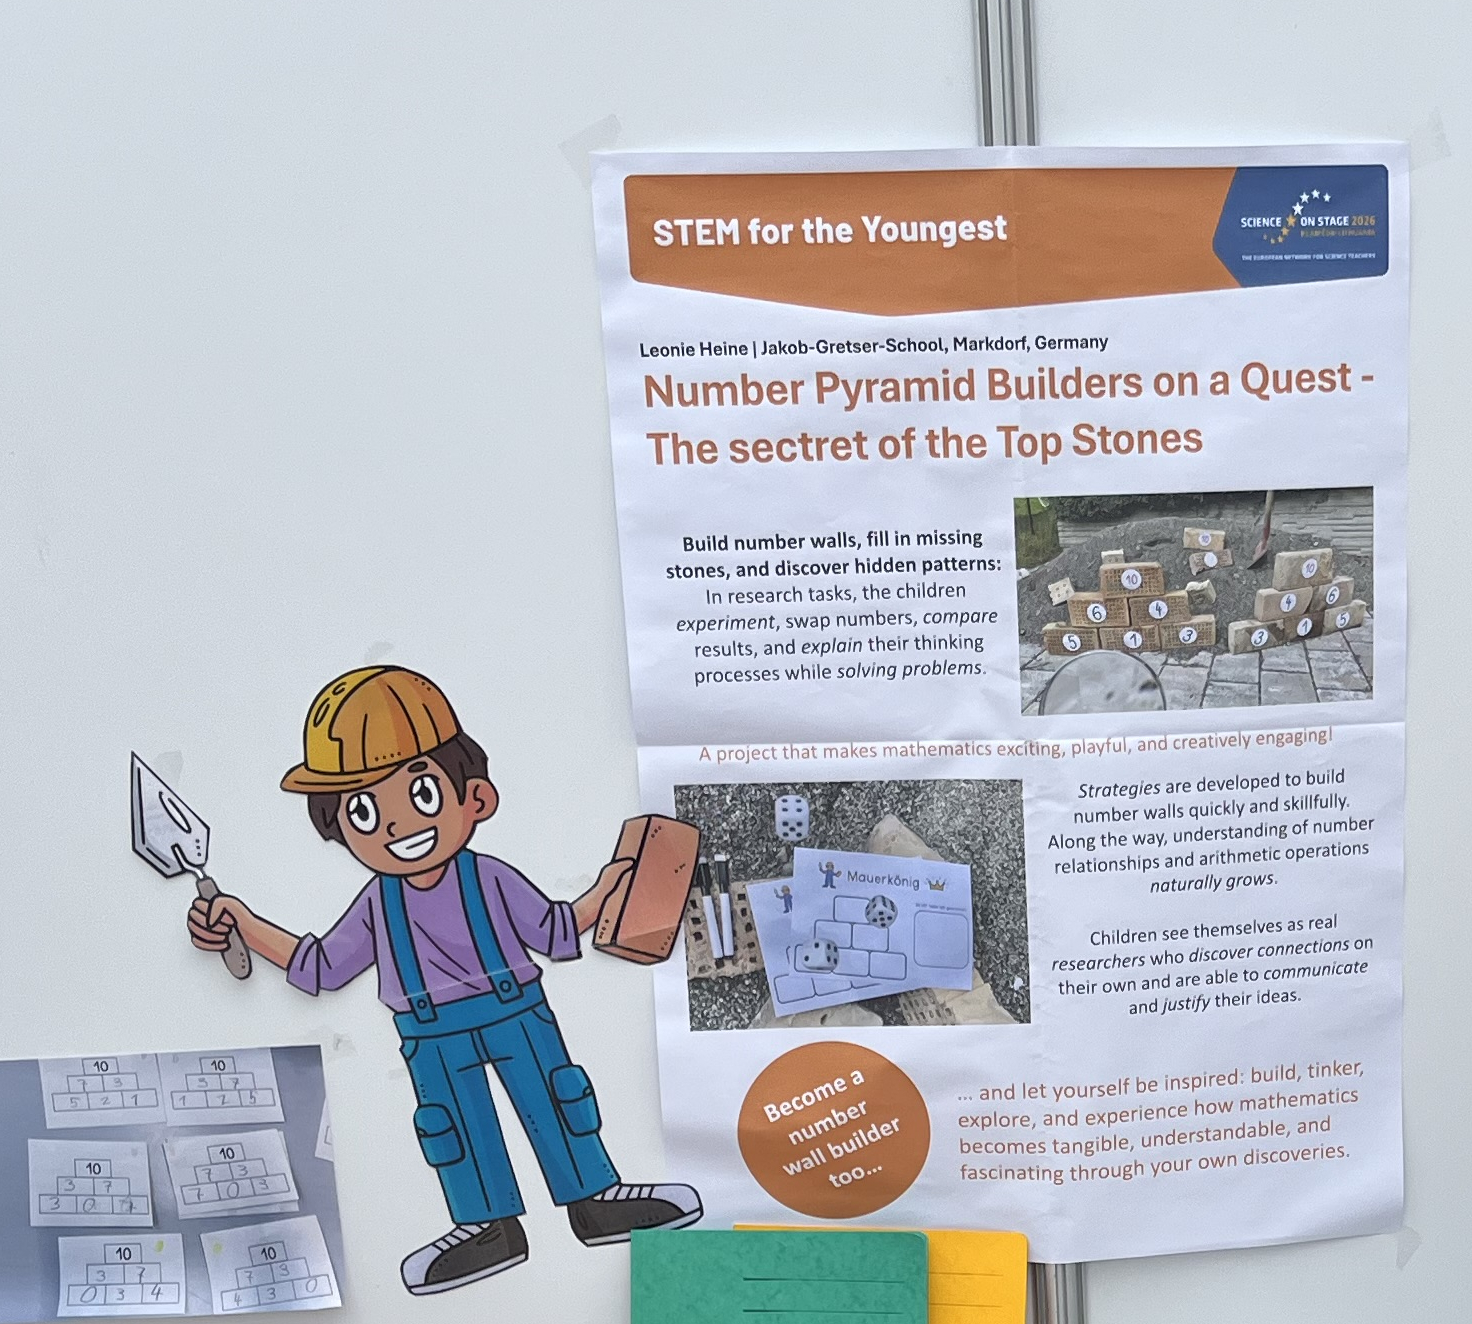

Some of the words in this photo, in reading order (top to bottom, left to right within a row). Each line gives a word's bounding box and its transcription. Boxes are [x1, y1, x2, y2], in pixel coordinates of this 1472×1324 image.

[653, 219, 739, 247] STEM
[748, 217, 794, 244] for
[802, 217, 853, 244] the
[861, 215, 1008, 248] Youngest
[1241, 217, 1281, 228] SCIENCE
[1301, 217, 1315, 227] ON
[1318, 216, 1349, 226] STAGE
[1351, 216, 1376, 226] 2026
[639, 341, 696, 358] Leonie
[699, 340, 749, 357] Heine
[760, 336, 949, 356] Jakob-Gretser-School,
[952, 334, 1031, 354] Markdorf,
[1034, 334, 1109, 353] Germany
[644, 372, 805, 408] Number
[815, 367, 976, 413] Pyramid
[987, 365, 1143, 401] Builders
[1153, 371, 1199, 398] on
[1209, 370, 1230, 396] a
[1240, 361, 1352, 402] Quest
[645, 431, 719, 466] The
[729, 430, 869, 464] sectret
[878, 426, 917, 460] of
[924, 425, 988, 459] the
[995, 425, 1063, 466] Top
[1072, 422, 1203, 456] Stones
[682, 534, 729, 553] Build
[734, 532, 806, 551] number
[809, 531, 862, 551] walls,
[866, 529, 890, 548] fill
[894, 529, 911, 547] in
[916, 528, 984, 549] missing
[665, 564, 731, 581] stones,
[735, 559, 770, 578] and
[774, 559, 850, 577] discover
[854, 556, 917, 575] hidden
[921, 556, 1002, 576] patterns:
[705, 588, 723, 605] In
[727, 585, 803, 605] research
[807, 583, 857, 604] tasks,
[861, 583, 892, 601] the
[896, 581, 966, 600] children
[676, 614, 781, 636] experiment,
[785, 615, 831, 632] swap
[835, 609, 918, 628] numbers,
[922, 611, 999, 628] compare
[694, 639, 758, 660] results,
[763, 638, 796, 656] and
[801, 636, 863, 658] explain
[867, 635, 910, 653] their
[913, 633, 985, 654] thinking
[694, 668, 780, 688] processes
[784, 663, 832, 681] while
[836, 661, 898, 681] solving
[901, 658, 987, 681] problems.
[700, 747, 711, 761] A
[717, 745, 777, 764] project
[782, 743, 817, 759] that
[823, 742, 877, 758] makes
[883, 740, 991, 757] mathematics
[997, 740, 1066, 759] exciting,
[1072, 737, 1131, 758] playful,
[1138, 734, 1167, 751] and
[1173, 731, 1250, 750] creatively
[1256, 726, 1333, 748] engaging!
[847, 870, 920, 891] Mauerkönig
[94, 1060, 109, 1073] 10
[211, 1060, 226, 1072] 10
[763, 1077, 848, 1123] Become
[850, 1070, 865, 1085] a
[788, 1100, 867, 1145] number
[219, 1148, 235, 1160] 10
[782, 1147, 827, 1176] wall
[827, 1117, 900, 1159] builder
[86, 1163, 101, 1175] 10
[829, 1165, 882, 1188] too...
[116, 1248, 132, 1261] 10
[261, 1247, 277, 1261] 10
